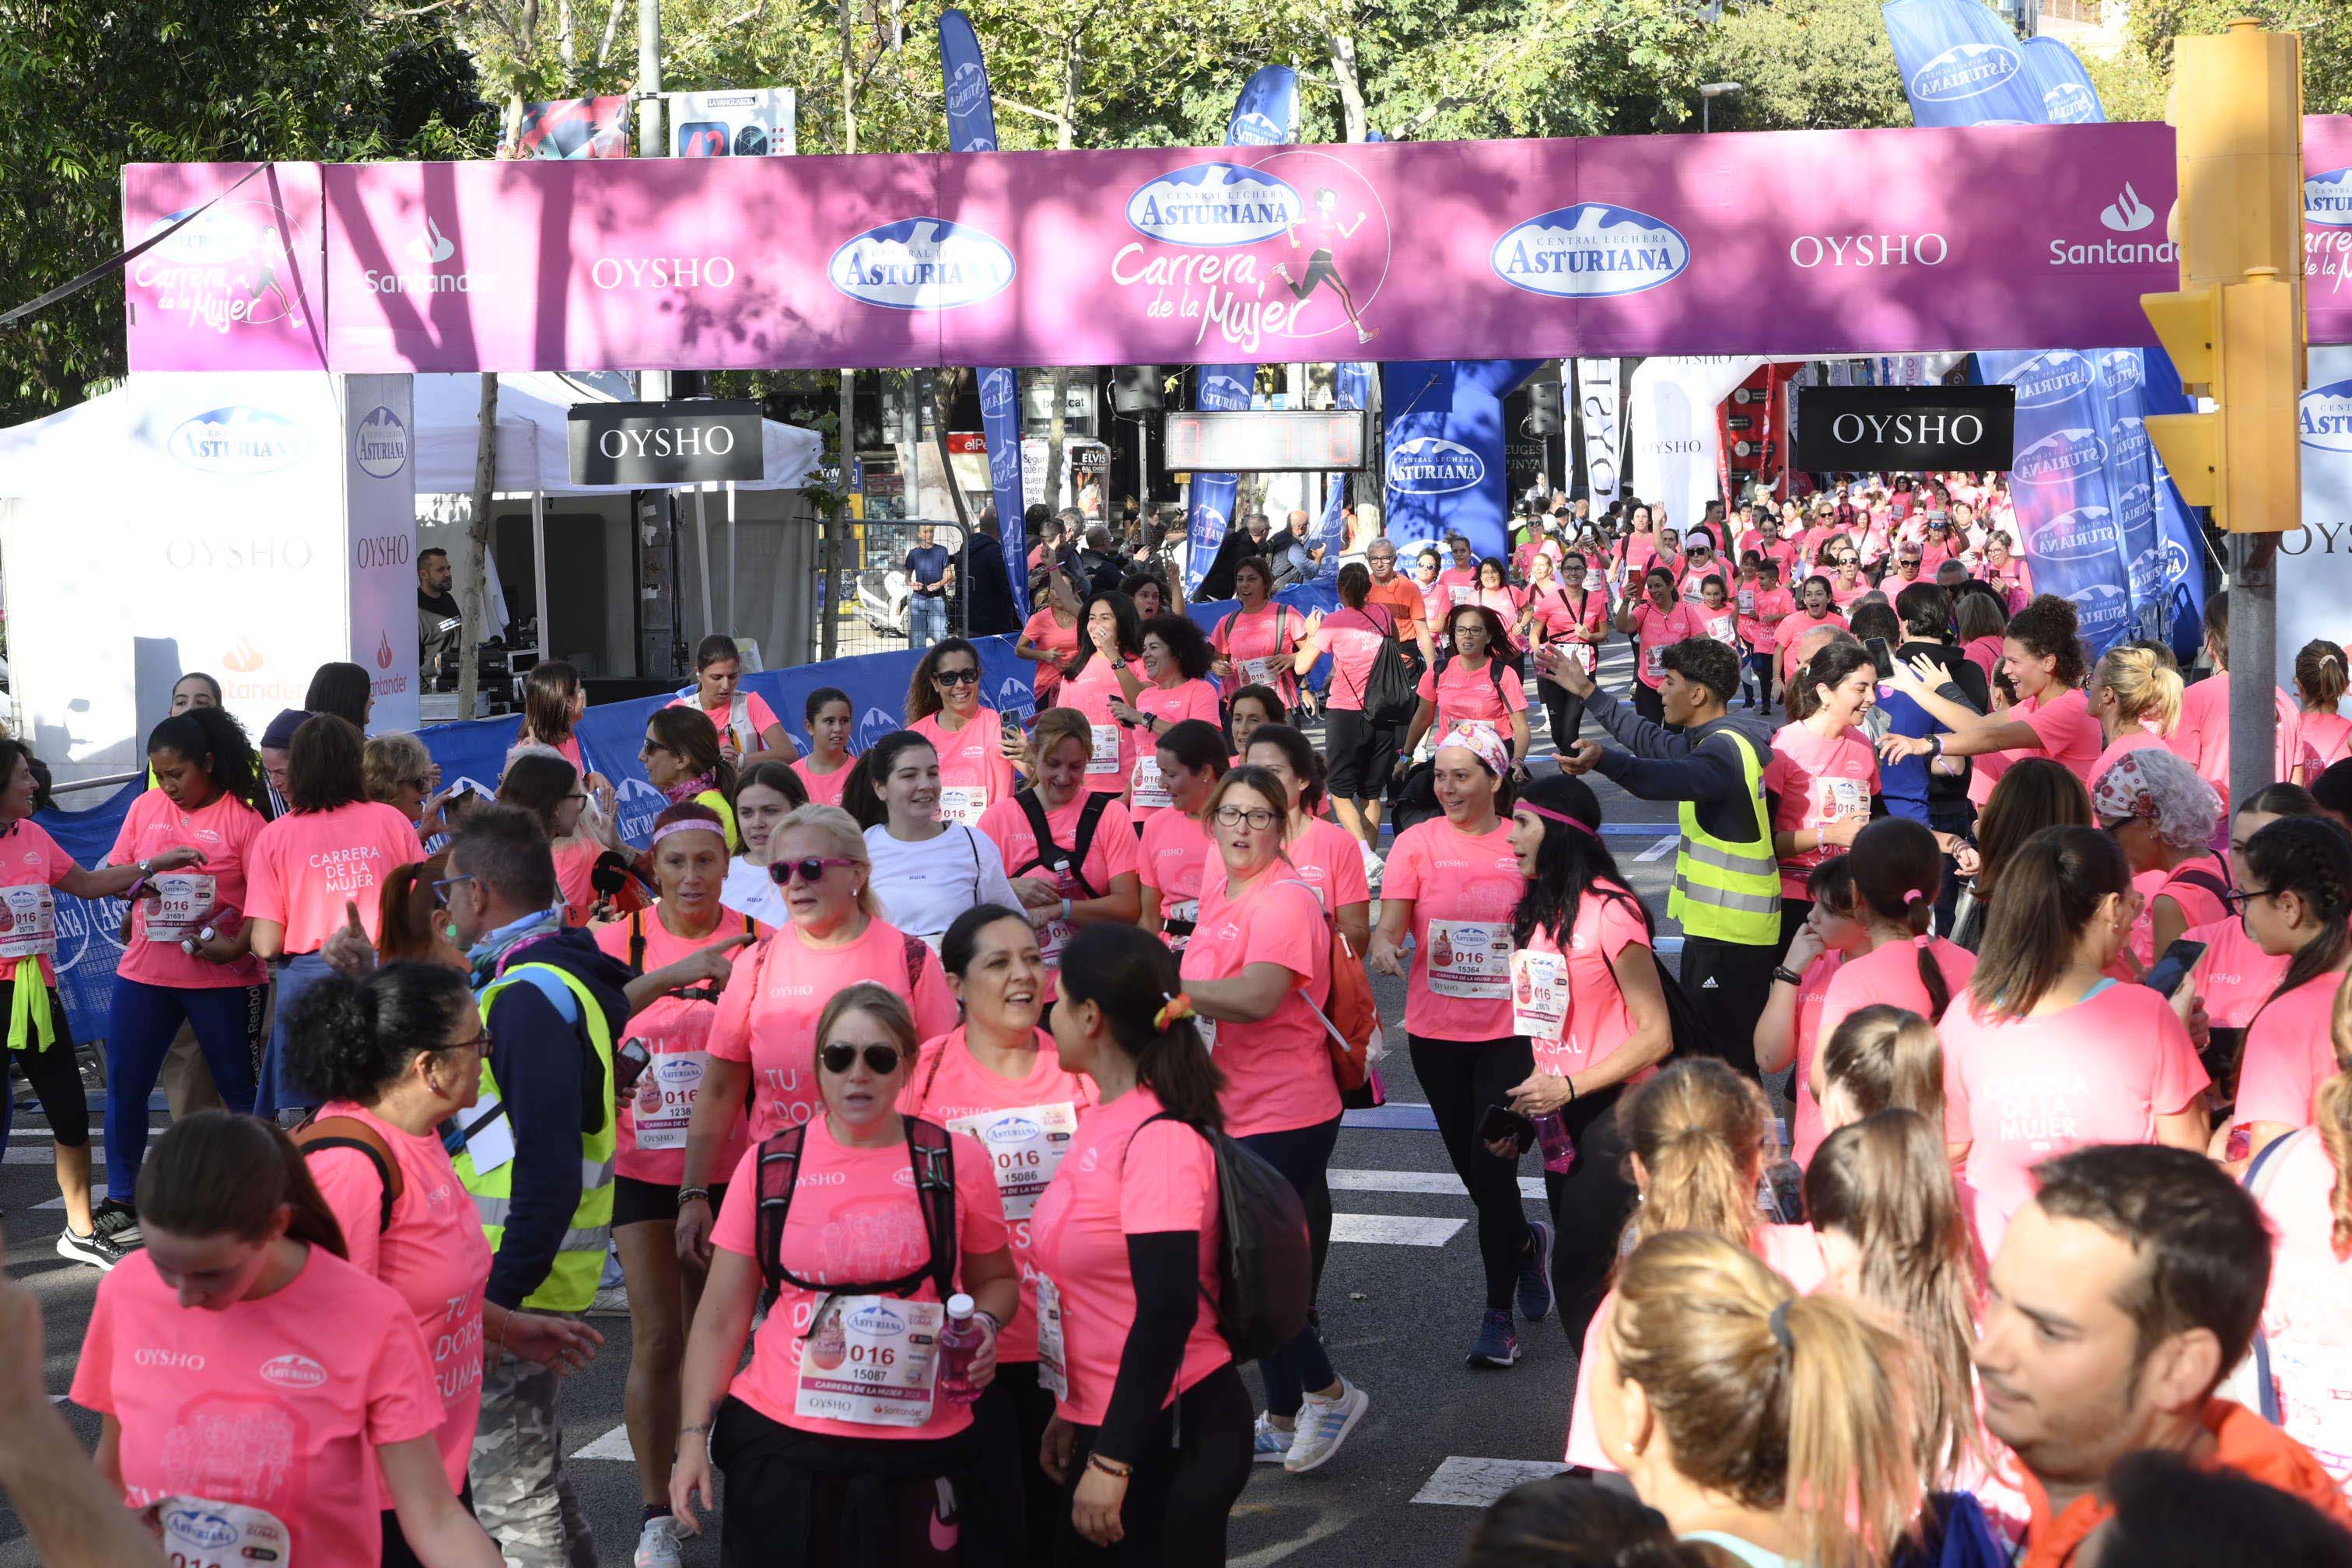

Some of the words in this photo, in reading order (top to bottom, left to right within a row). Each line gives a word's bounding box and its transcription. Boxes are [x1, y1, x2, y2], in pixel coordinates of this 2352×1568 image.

[716, 97, 754, 106] VANGUARDIA
[1167, 191, 1222, 200] CENTRAL
[1227, 189, 1285, 199] LECHERA
[1139, 194, 1289, 226] ASTURIANA
[1536, 236, 1598, 246] CENTRAL
[1605, 234, 1668, 245] LECHERA
[1506, 239, 1675, 275] ASTURIANA
[1790, 233, 1948, 268] OYSHO
[135, 259, 225, 288] Carrera
[591, 256, 735, 290] OYSHO
[1111, 242, 1258, 286] Carrera
[2322, 252, 2336, 275] la
[364, 268, 498, 294] Santander
[158, 294, 175, 309] de
[188, 285, 261, 333] Mujer
[1147, 289, 1174, 319] de
[1180, 287, 1199, 318] la
[1195, 282, 1312, 354] Mujer
[1832, 413, 1983, 446] OYSHO
[359, 434, 405, 461] ASTURIANA
[599, 425, 735, 459] OYSHO
[1082, 453, 1106, 464] ELVIS
[1390, 459, 1478, 481] ASTURIANA
[166, 536, 313, 569] OYSHO
[357, 534, 409, 569] OYSHO
[1838, 803, 1855, 814] 016
[310, 845, 381, 868] CARRERA
[325, 863, 345, 879] DE
[350, 860, 370, 875] LA
[326, 873, 374, 894] MUJER
[163, 900, 189, 911] 016
[16, 912, 36, 923] 016
[2, 945, 26, 954] OYSHO
[1455, 951, 1484, 964] 016
[770, 985, 814, 999] OYSHO
[1434, 982, 1458, 991] OYSHO
[662, 1066, 700, 1080] ASTURIANA
[765, 1069, 796, 1090] TU
[938, 1105, 993, 1118] OYSHO
[644, 1134, 674, 1143] OYSHO
[990, 1128, 1037, 1139] ASTURIANA
[1999, 1118, 2078, 1142] MUJER
[998, 1150, 1040, 1168] 016
[1005, 1171, 1038, 1183] 15086
[852, 1317, 902, 1332] ASTURIANA
[134, 1348, 205, 1370] OYSHO
[850, 1345, 895, 1366] 016
[852, 1368, 887, 1382] 15087
[814, 1381, 852, 1393] CARRERA
[853, 1385, 866, 1394] DE
[866, 1386, 877, 1395] LA
[877, 1387, 903, 1396] MUJER
[810, 1398, 852, 1412] OYSHO
[883, 1403, 922, 1416] Santander
[170, 1517, 235, 1544] ASTURIANA
